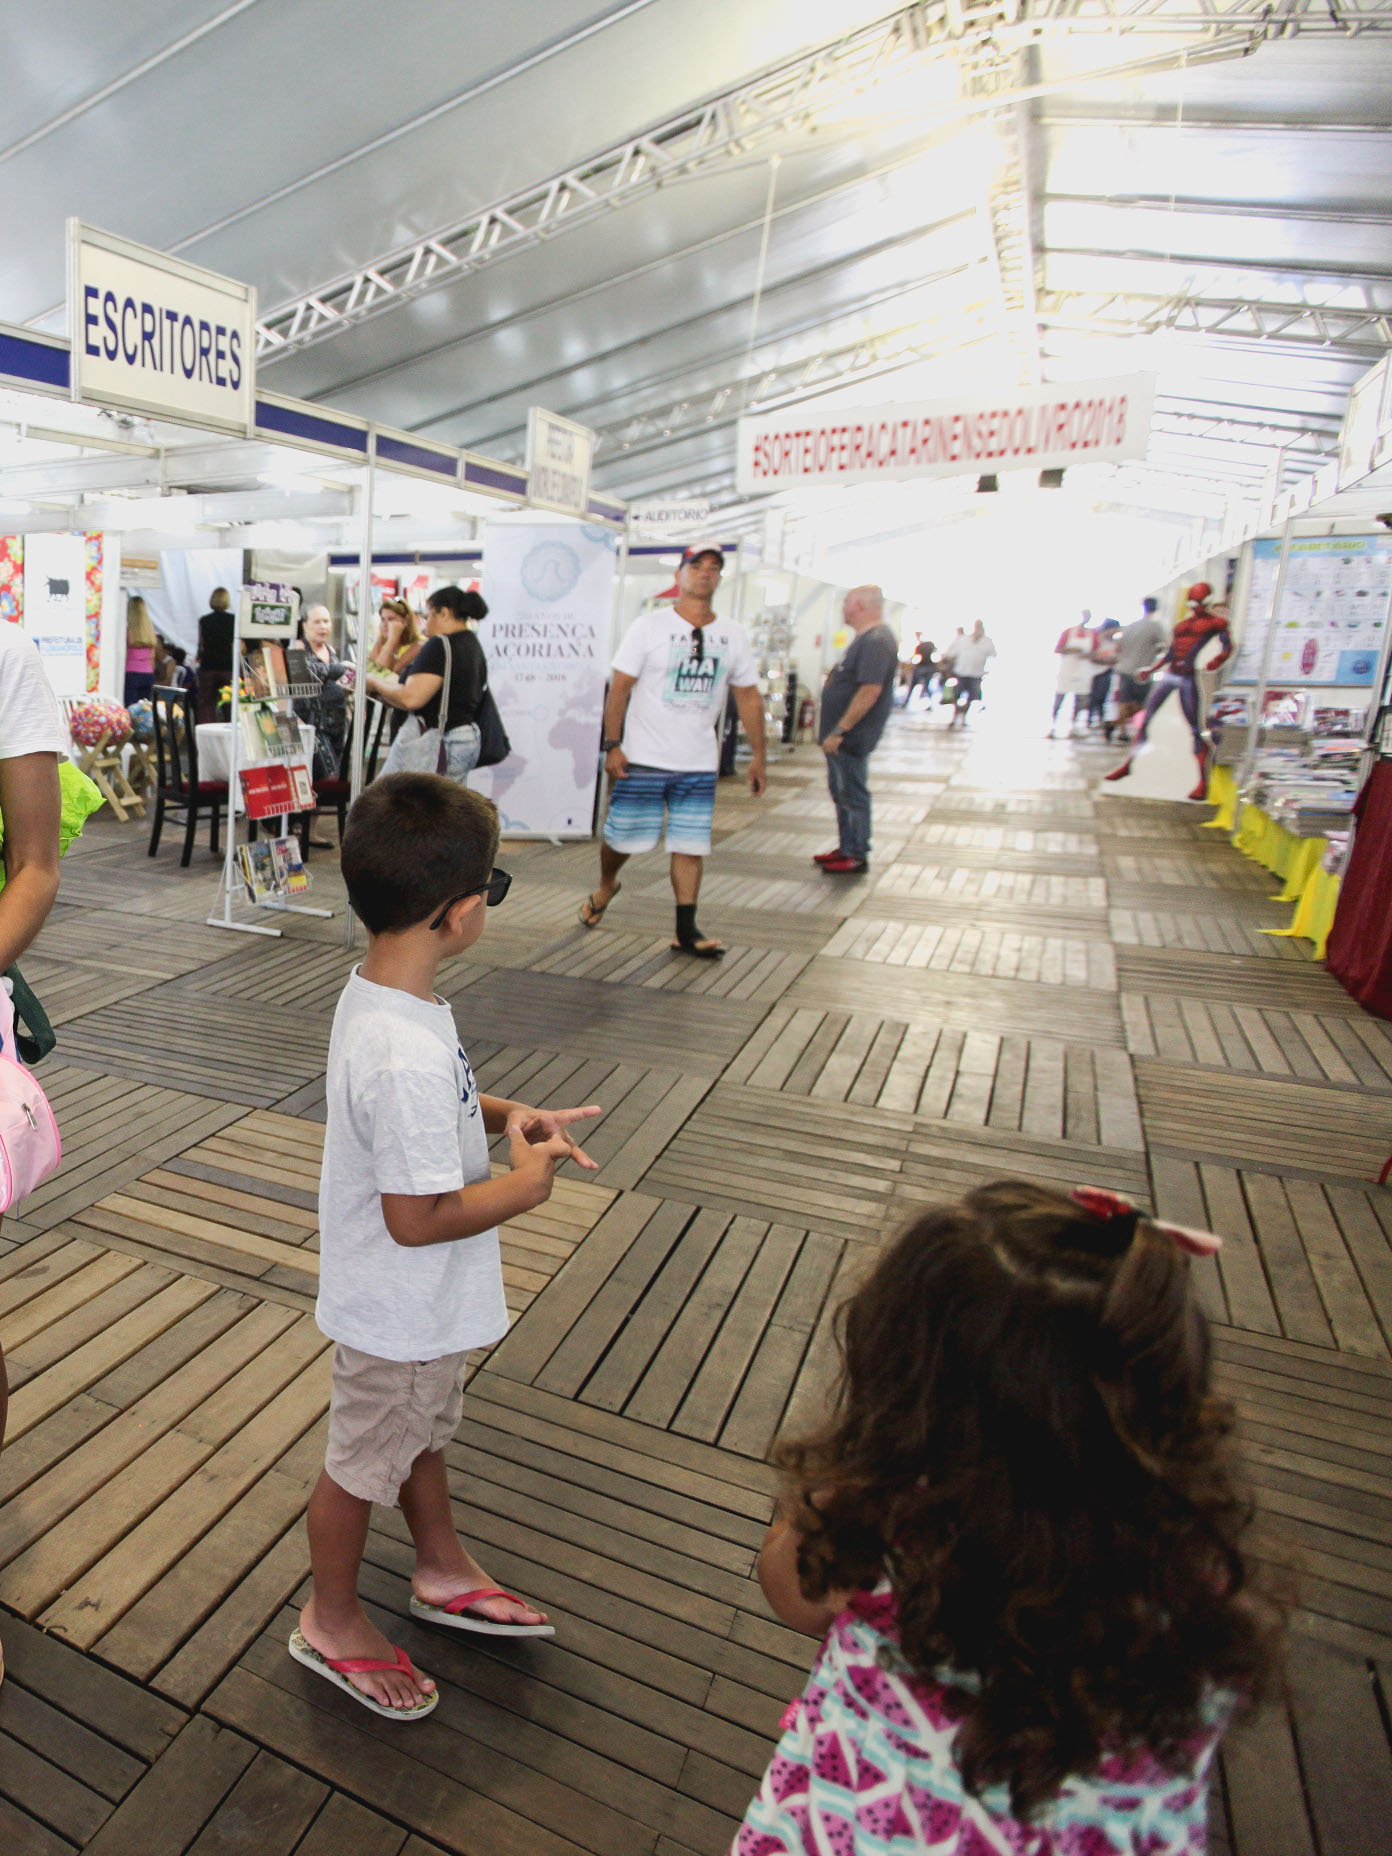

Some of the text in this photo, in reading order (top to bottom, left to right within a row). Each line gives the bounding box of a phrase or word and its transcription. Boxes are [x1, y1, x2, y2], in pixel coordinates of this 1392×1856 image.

[84, 284, 241, 391] ESCRITORES
[491, 623, 596, 642] PRESENÇA
[490, 642, 595, 662] AÇORIANA
